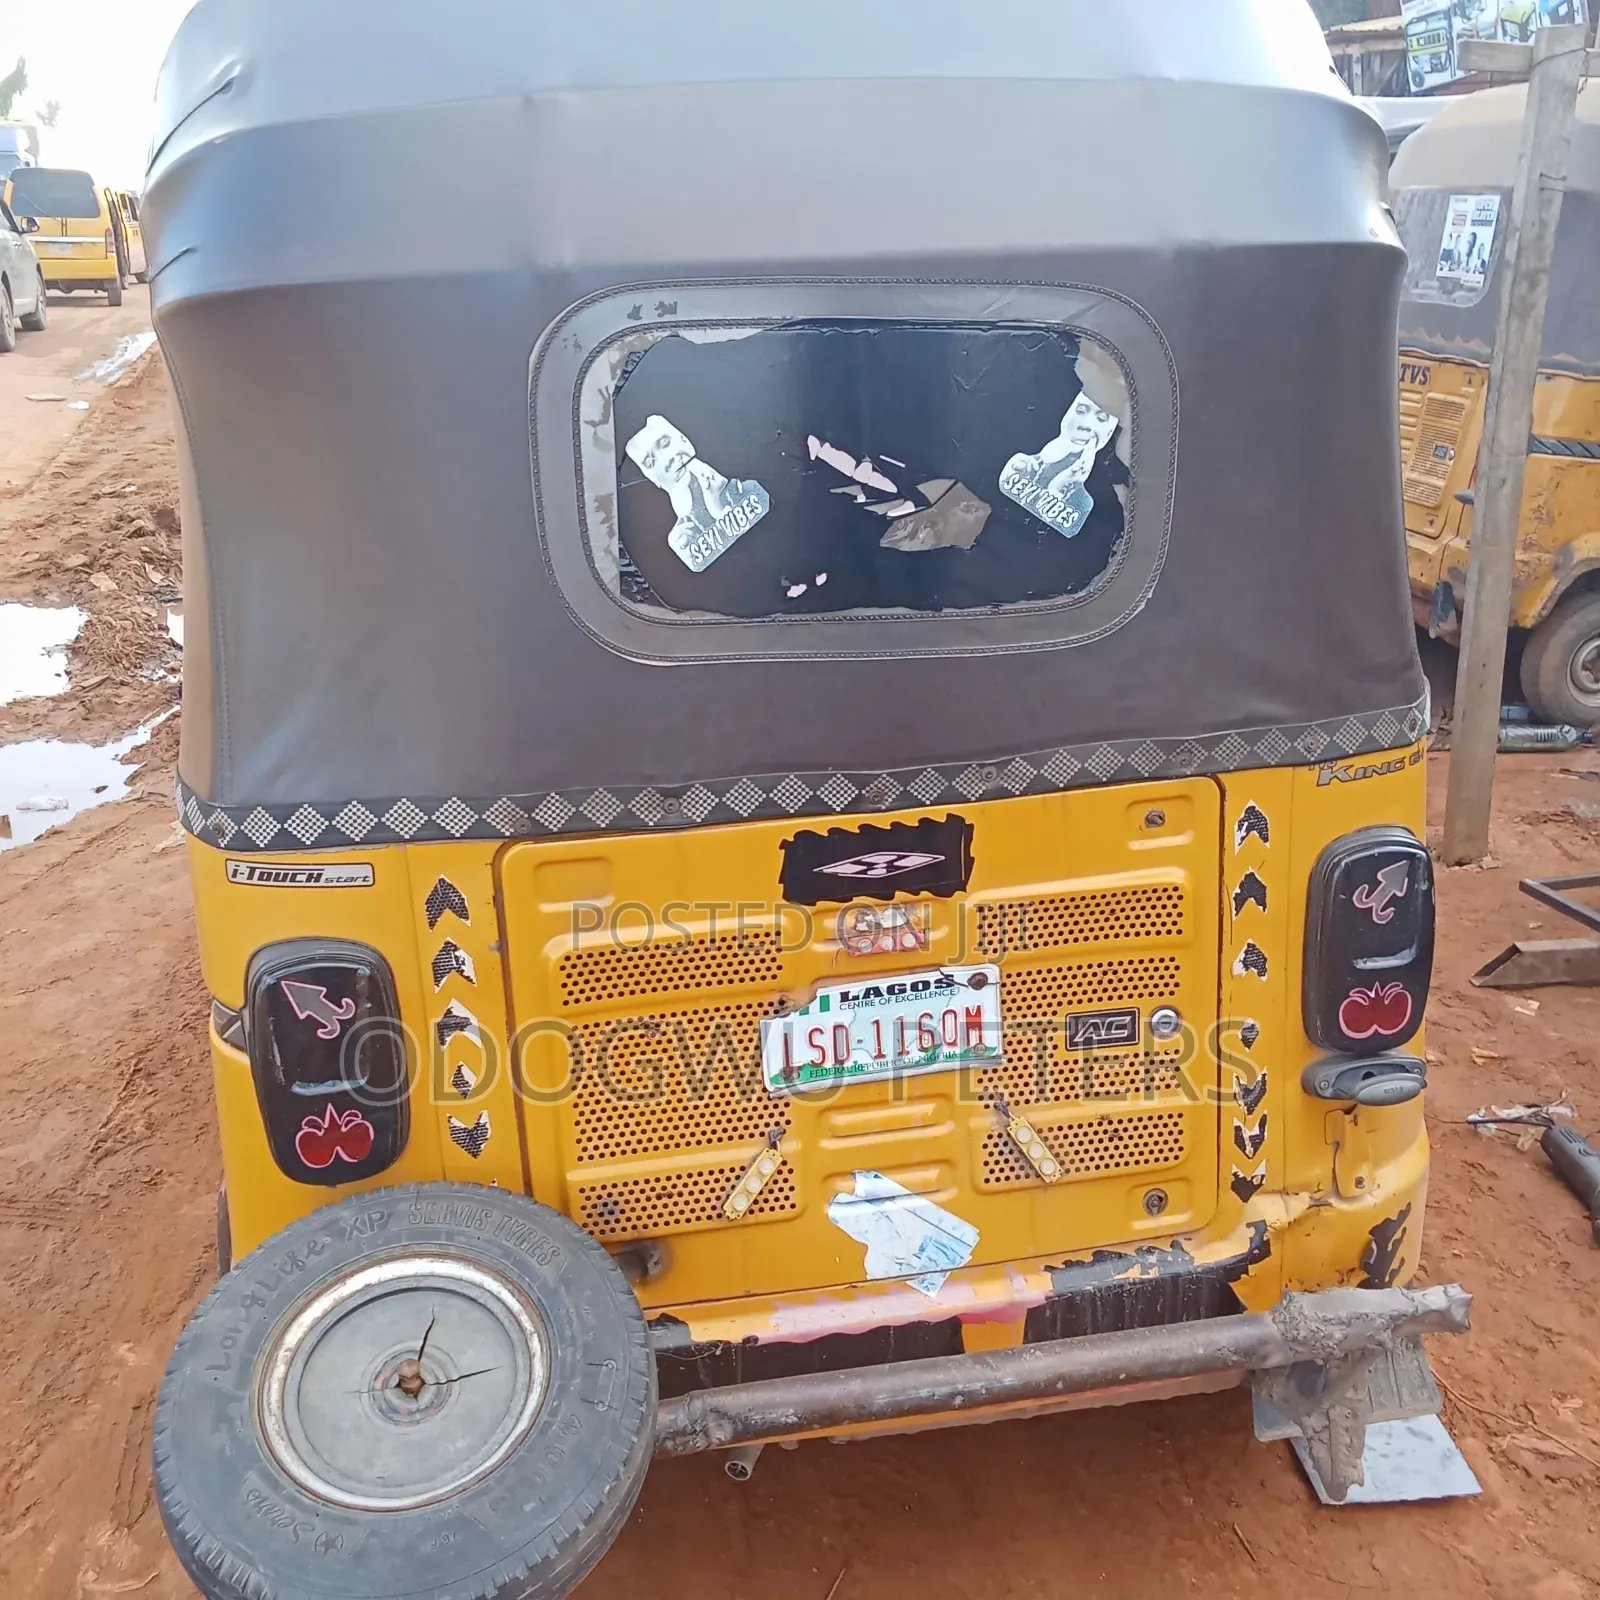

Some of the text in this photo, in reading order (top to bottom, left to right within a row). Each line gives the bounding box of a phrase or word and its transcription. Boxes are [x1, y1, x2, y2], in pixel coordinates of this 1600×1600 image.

[1400, 363, 1430, 386] TVS
[1004, 473, 1079, 528] SEYI VIBES
[689, 494, 764, 564] SEYI VIBES
[324, 875, 370, 884] start
[839, 974, 955, 1003] LAGOS
[839, 988, 956, 1011] CENTRE OF EXCELLENCE
[809, 1065, 853, 1079] FEDERAL
[903, 1055, 915, 1065] OF
[918, 1050, 958, 1064] NIGERIA
[340, 1209, 387, 1241] XP
[409, 1201, 561, 1267] SERVIS TYRES
